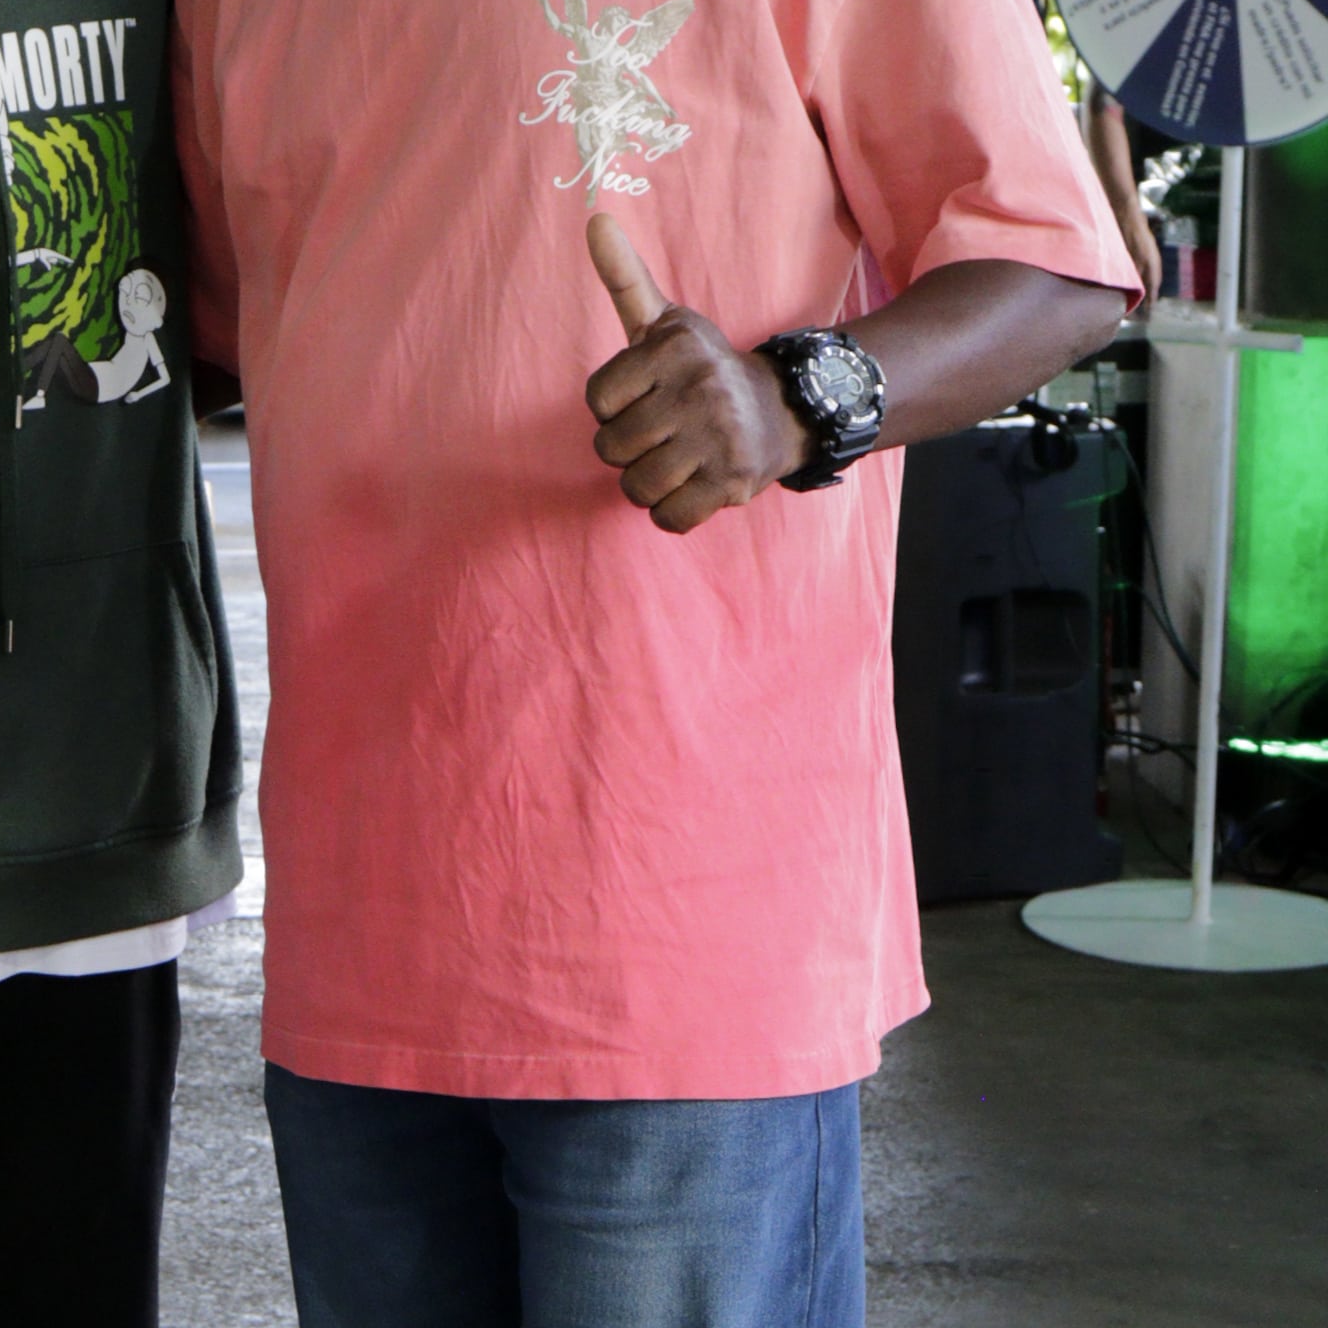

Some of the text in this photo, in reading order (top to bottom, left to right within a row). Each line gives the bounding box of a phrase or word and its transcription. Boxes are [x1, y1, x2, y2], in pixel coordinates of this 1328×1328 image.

[567, 18, 654, 71] Too
[519, 69, 692, 162] Fucking
[554, 138, 651, 197] Nice
